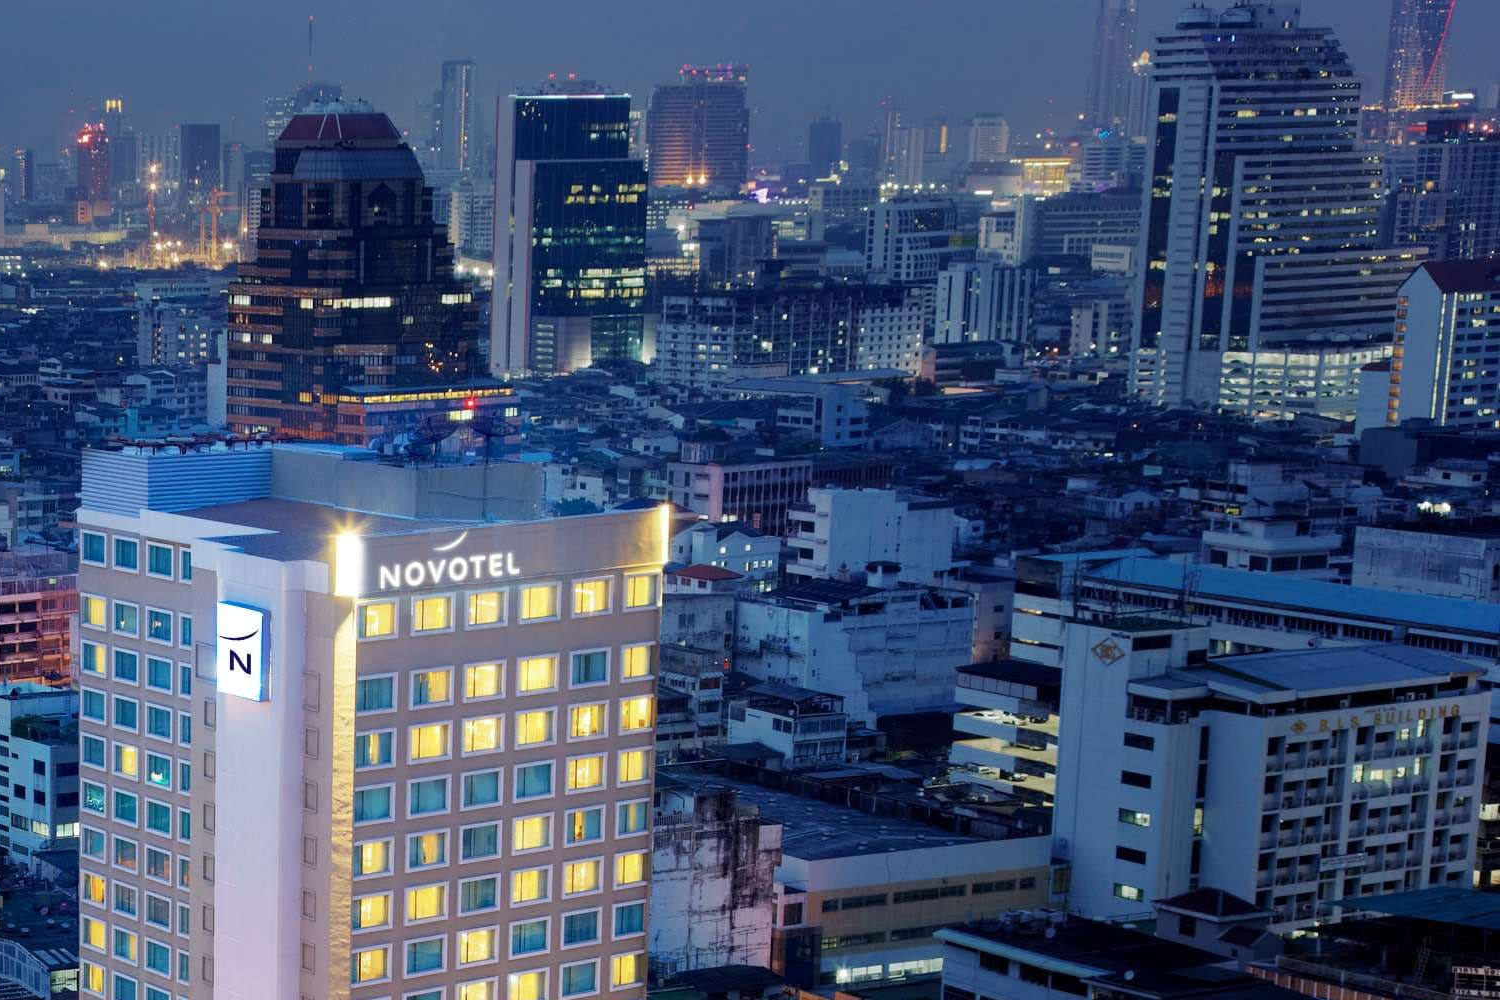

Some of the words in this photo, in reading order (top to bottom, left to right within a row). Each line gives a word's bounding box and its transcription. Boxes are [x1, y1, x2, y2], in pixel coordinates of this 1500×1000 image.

[379, 552, 521, 590] NOVOTEL
[228, 648, 253, 676] N
[1373, 703, 1461, 726] BUILDING
